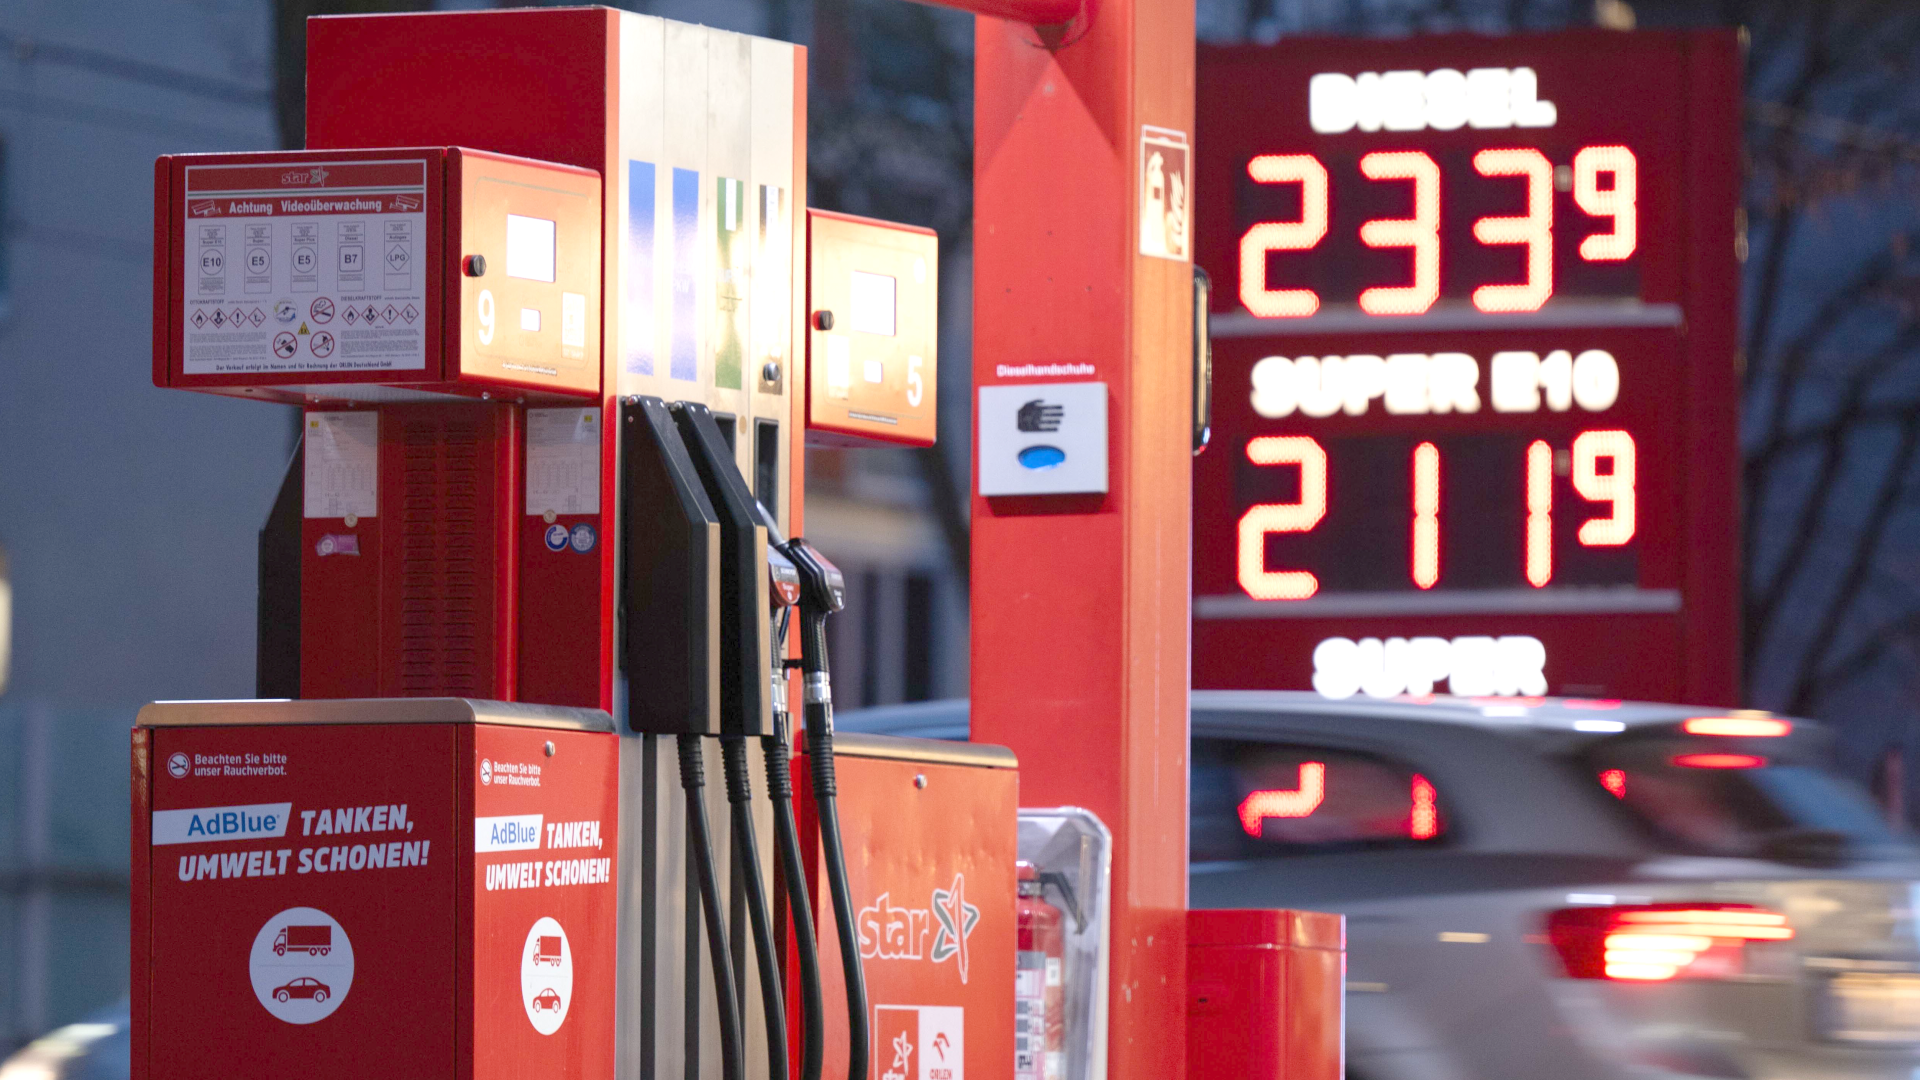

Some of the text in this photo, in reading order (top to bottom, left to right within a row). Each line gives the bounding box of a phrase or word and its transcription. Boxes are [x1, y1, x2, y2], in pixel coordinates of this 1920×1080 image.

[1309, 66, 1557, 133] DIESEL
[281, 170, 310, 184] star
[229, 199, 382, 215] Achtung Videoüberwachung
[203, 257, 221, 267] E10
[251, 256, 265, 266] E5
[298, 255, 311, 265] E5
[345, 254, 358, 264] B7
[390, 254, 406, 262] LPG
[478, 289, 495, 346] 9
[245, 363, 262, 371] erfolgt
[996, 363, 1095, 377] Dieselhandschuhe
[907, 355, 923, 407] 5
[1251, 349, 1620, 418] SUPER E10
[1312, 635, 1548, 700] SUPER
[194, 752, 287, 765] Beachten Sie bitte
[194, 764, 287, 777] unser Rauchverbot.
[494, 761, 541, 776] Beachten Sie bitte
[494, 774, 541, 787] unser Rauchverbot.
[300, 804, 414, 836] TANKEN,
[546, 821, 603, 850] TANKEN,
[178, 840, 431, 882] UMWELT SCHONEN!
[485, 857, 611, 891] UMWELT SCHONEN!
[858, 892, 929, 960] star
